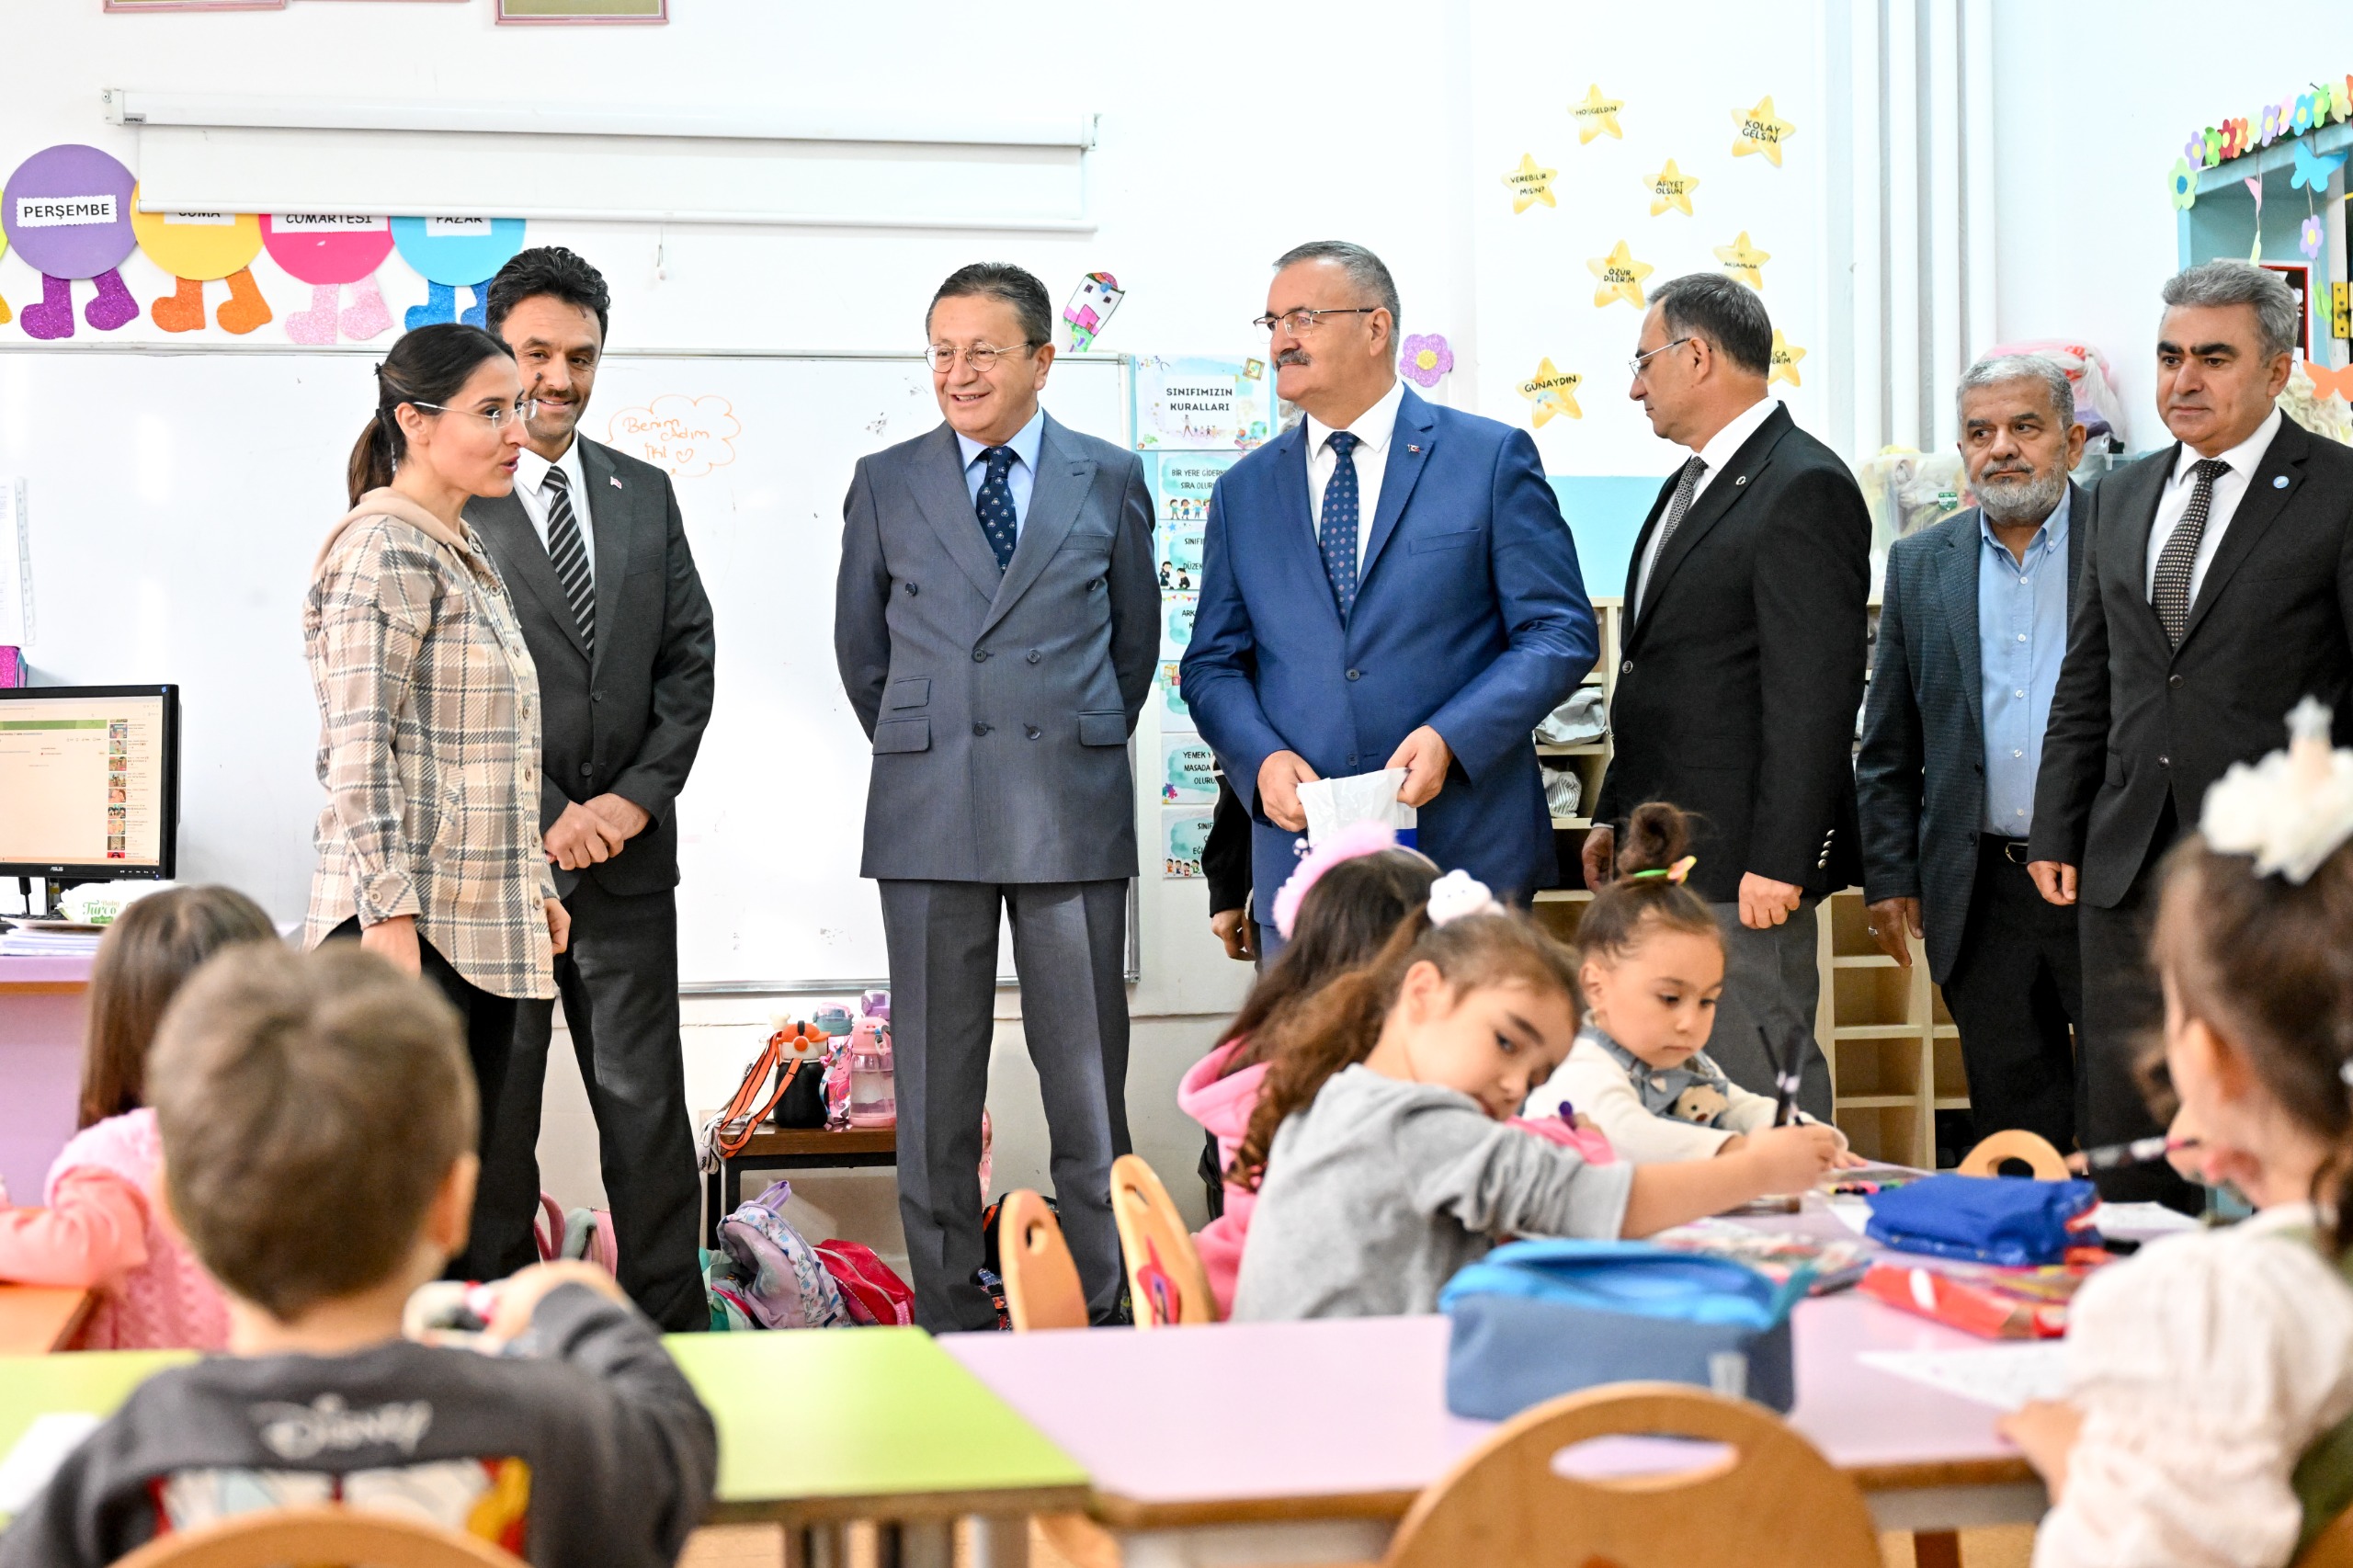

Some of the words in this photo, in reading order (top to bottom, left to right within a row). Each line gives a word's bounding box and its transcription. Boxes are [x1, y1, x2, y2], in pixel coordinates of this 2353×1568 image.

[1745, 119, 1781, 135] KOLAY
[1655, 187, 1683, 195] OLSUN
[24, 203, 110, 220] PERŞEMBE
[1165, 387, 1233, 397] SINIFIMIZIN
[1169, 403, 1231, 412] KURALLARI
[622, 416, 680, 434] Benim
[1183, 751, 1207, 759] YEMEK
[1183, 764, 1211, 772] MASADA
[82, 899, 117, 915] Turco
